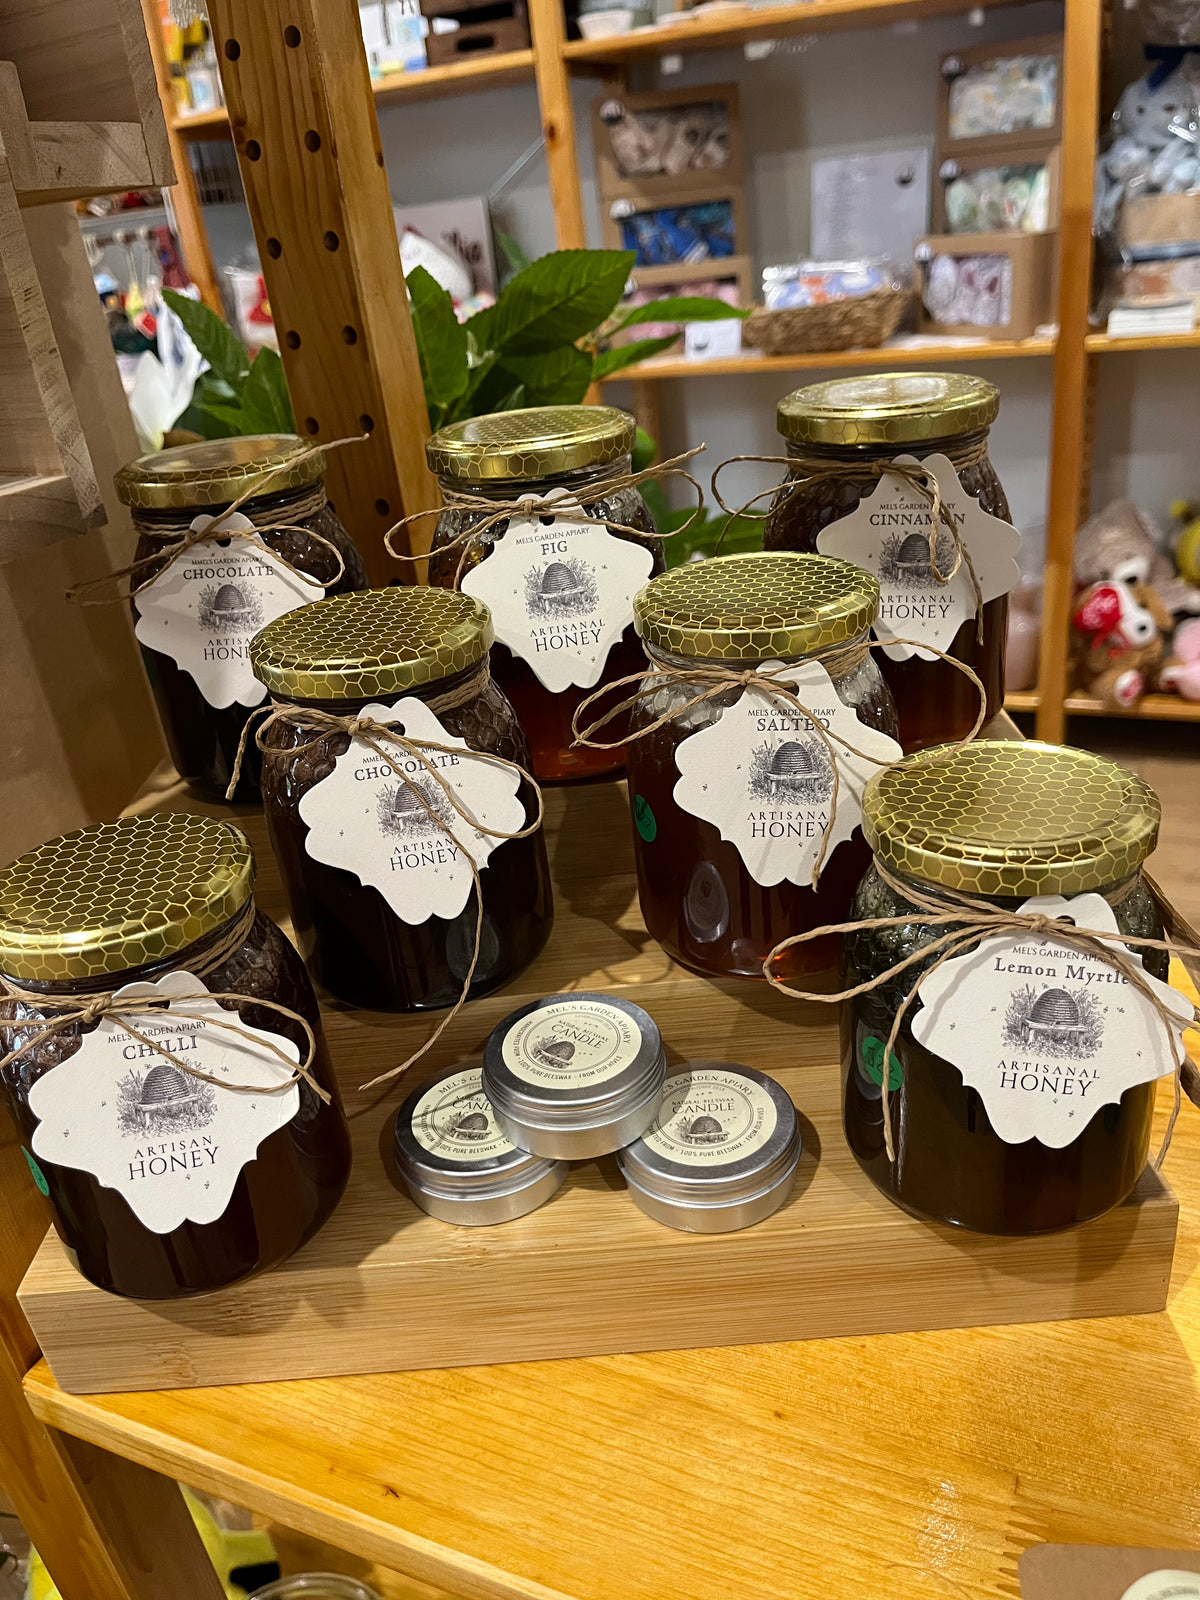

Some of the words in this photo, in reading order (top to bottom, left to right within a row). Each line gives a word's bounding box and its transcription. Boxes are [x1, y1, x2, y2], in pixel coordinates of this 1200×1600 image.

[516, 536, 534, 546] MEL'S
[535, 532, 564, 542] GARDEN
[566, 528, 590, 538] APIARY
[540, 540, 568, 556] FIG
[182, 566, 274, 580] CHOCOLATE
[881, 604, 950, 619] HONEY
[530, 618, 606, 638] ARTISANAL
[208, 638, 250, 646] ARTISA
[534, 628, 602, 652] HONEY
[811, 708, 836, 716] PIARY
[747, 812, 828, 820] ARTISANA
[752, 822, 830, 838] HONEY
[393, 838, 454, 854] ARTISAN
[390, 847, 459, 872] HONEY
[1012, 946, 1037, 956] MEL'S
[1038, 948, 1080, 960] GARDEN
[994, 957, 1056, 978] Lemon
[1064, 964, 1130, 986] Myrtle
[108, 1032, 132, 1044] MEL'S
[139, 1026, 172, 1038] ARDEN
[175, 1020, 208, 1033] APIARY
[546, 1005, 577, 1016] MEL'S
[580, 1004, 618, 1020] GARDEN
[617, 1020, 632, 1045] APIARY
[552, 1024, 606, 1049] CANDLE
[122, 1034, 198, 1060] CHILLI
[530, 1068, 544, 1078] PURE
[578, 1070, 596, 1078] FROM
[997, 1060, 1100, 1079] ARTISANAL
[438, 1078, 466, 1094] MEL'S
[674, 1075, 720, 1086] GARDEN
[720, 1077, 756, 1096] APIARY
[1000, 1072, 1094, 1097] HONEY
[452, 1100, 494, 1112] CAND
[672, 1102, 736, 1114] CANDLE
[134, 1136, 214, 1159] ARTISAN
[468, 1144, 497, 1154] BEESWAX
[660, 1140, 675, 1150] FROM
[716, 1142, 743, 1156] BEESWAX
[128, 1146, 220, 1180] HONEY
